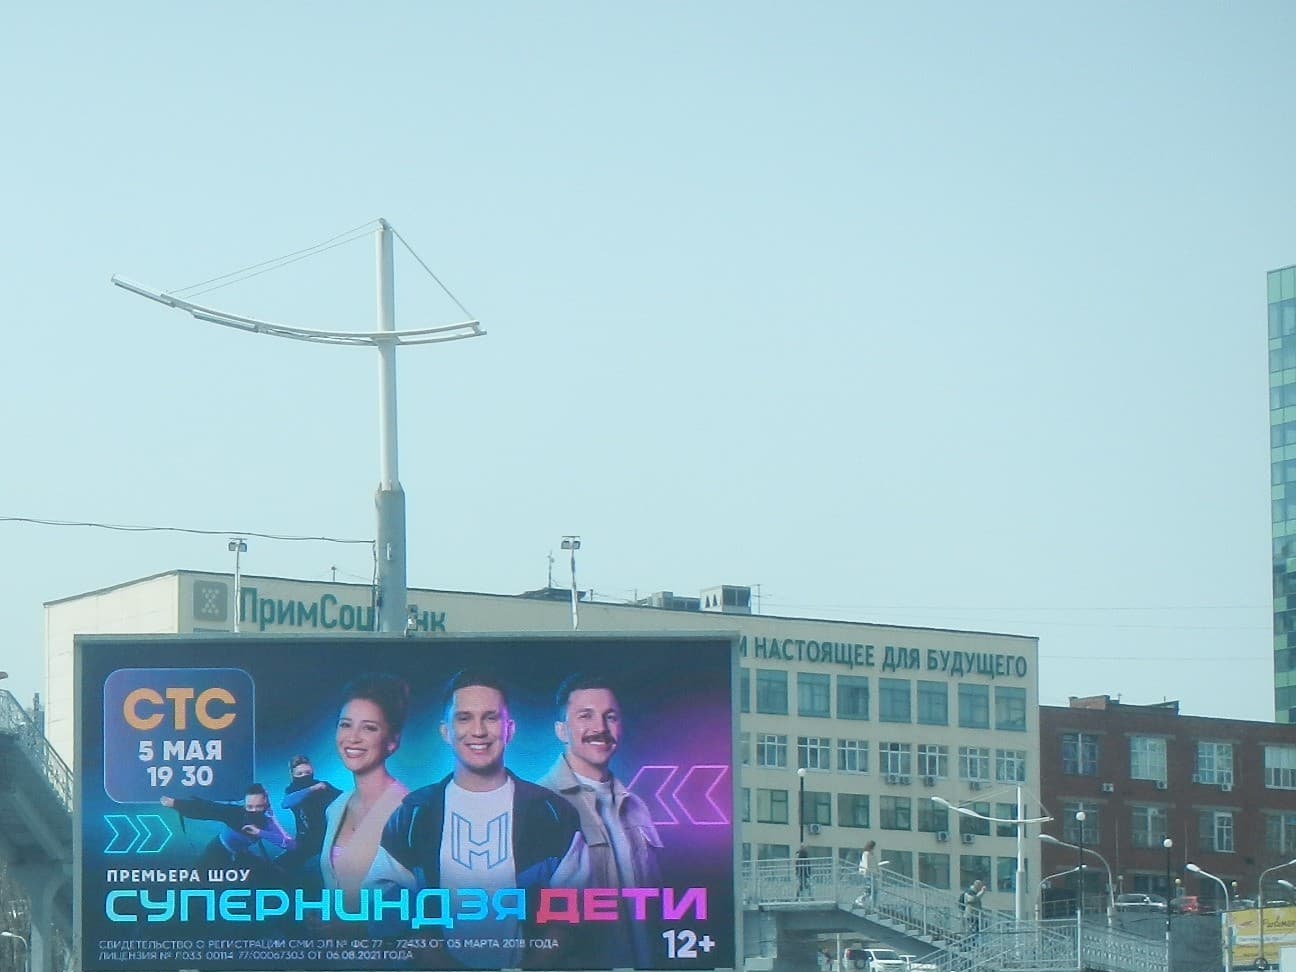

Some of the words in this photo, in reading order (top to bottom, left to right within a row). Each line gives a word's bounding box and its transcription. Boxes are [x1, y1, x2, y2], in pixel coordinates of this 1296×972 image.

[240, 587, 446, 632] ПримСоцнк
[755, 638, 875, 669] НАСТОЯЩЕЕ
[882, 646, 920, 672] ДЛЯ
[927, 649, 1028, 679] БУДУЩЕГО
[123, 687, 237, 731] СТС
[138, 740, 154, 762] 5
[163, 739, 222, 761] МАЯ
[146, 766, 173, 787] 19
[180, 765, 214, 787] 30
[106, 869, 201, 883] ПРЕМЬЕРА
[208, 868, 251, 882] ШОУ
[105, 888, 527, 929] СУПЕРНИНДЗЯ
[536, 887, 708, 924] ДЕТИ
[99, 940, 193, 951] СВИДЕТЕЛЬСТВО
[208, 940, 286, 951] РЕГИСТРАЦИИ
[288, 939, 314, 949] СМИ
[464, 939, 500, 949] МАРТА
[503, 939, 526, 949] 2018
[529, 939, 560, 950] ГОДА
[99, 950, 157, 962] ЛИЦЕНЗИЯ
[308, 950, 322, 960] ОТ
[384, 950, 413, 961] ГОДА
[662, 929, 716, 959] 12+
